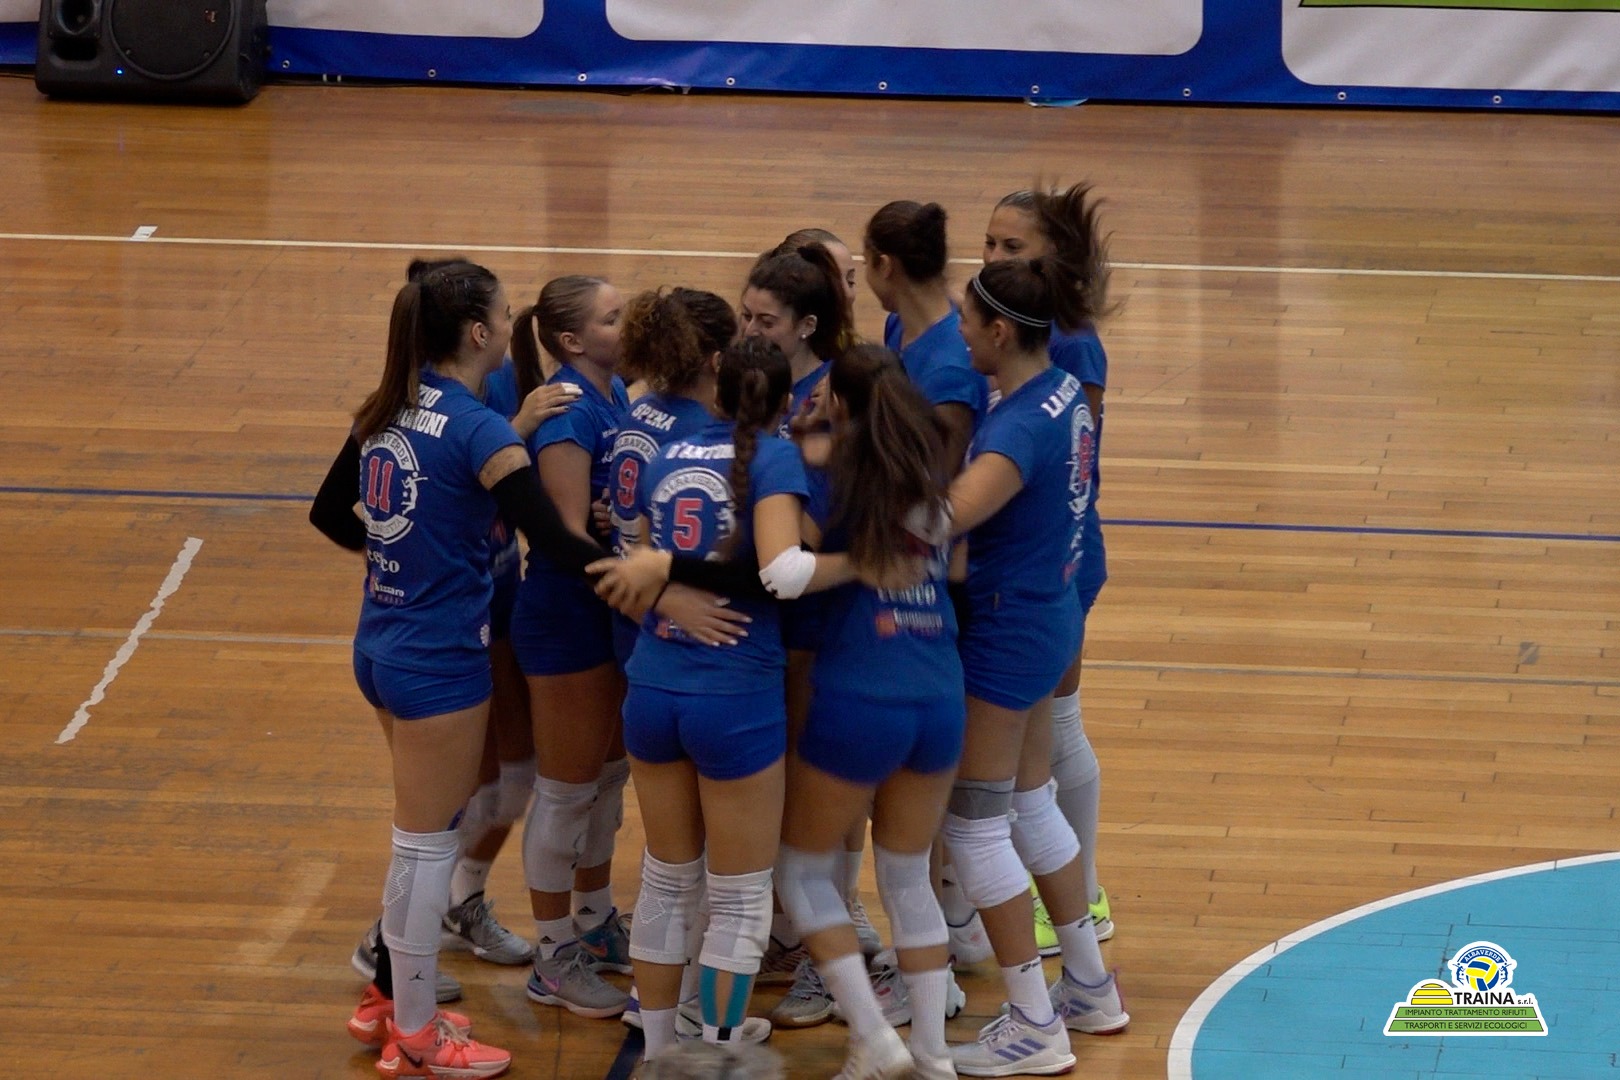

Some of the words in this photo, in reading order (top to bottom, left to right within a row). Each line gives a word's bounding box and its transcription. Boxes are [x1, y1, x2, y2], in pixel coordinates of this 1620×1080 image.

[367, 455, 394, 511] 11
[617, 457, 639, 508] 9
[672, 497, 704, 550] 5
